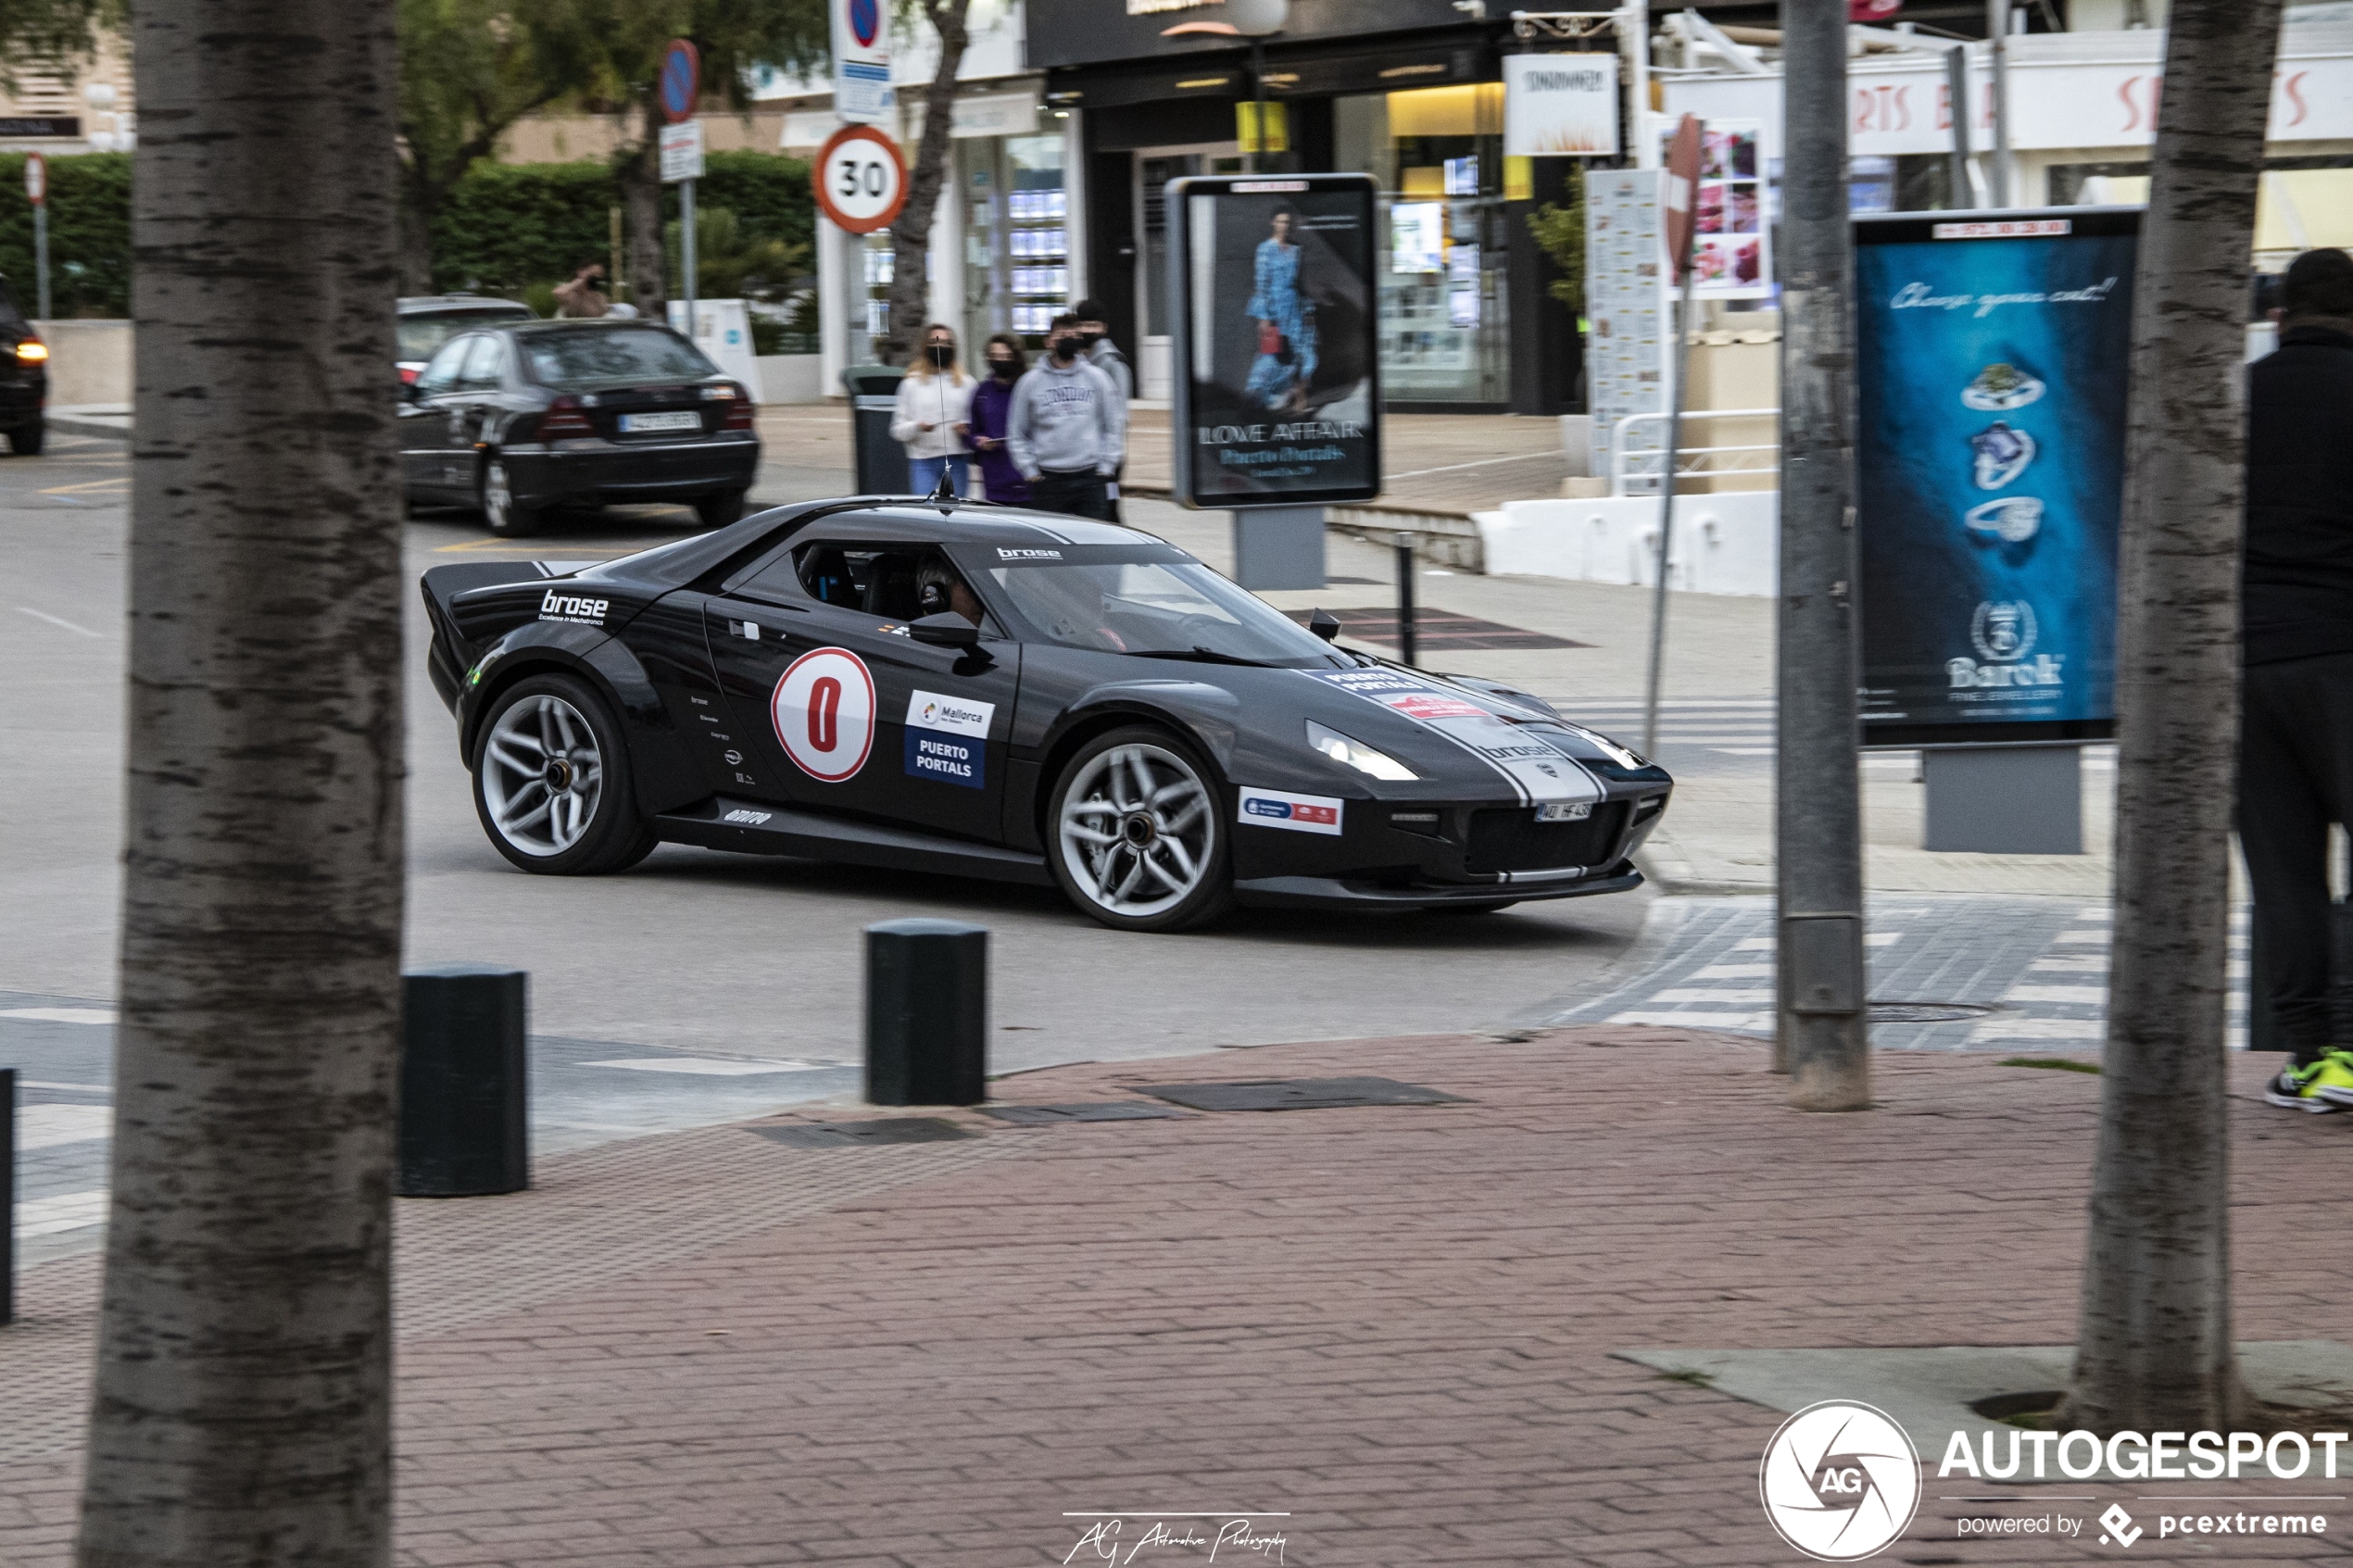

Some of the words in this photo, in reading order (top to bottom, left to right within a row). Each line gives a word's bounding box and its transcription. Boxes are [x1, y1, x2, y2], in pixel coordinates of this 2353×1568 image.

[1854, 84, 1911, 134] RTS
[838, 160, 887, 197] 30
[1199, 423, 1267, 445] LOVE
[1270, 420, 1364, 442] AFFAIR
[1220, 448, 1278, 464] Puerto
[1279, 445, 1346, 462] Portals
[997, 547, 1063, 558] brose
[541, 589, 609, 618] brose
[1325, 672, 1398, 683] PUERTO
[1945, 654, 2065, 687] Barok
[1340, 681, 1424, 692] PORTALS
[691, 696, 709, 705] brose
[808, 676, 841, 752] 0
[941, 706, 982, 723] Mallorca
[920, 739, 969, 760] PUERTO
[1477, 746, 1557, 759] brose
[916, 755, 972, 777] PORTALS
